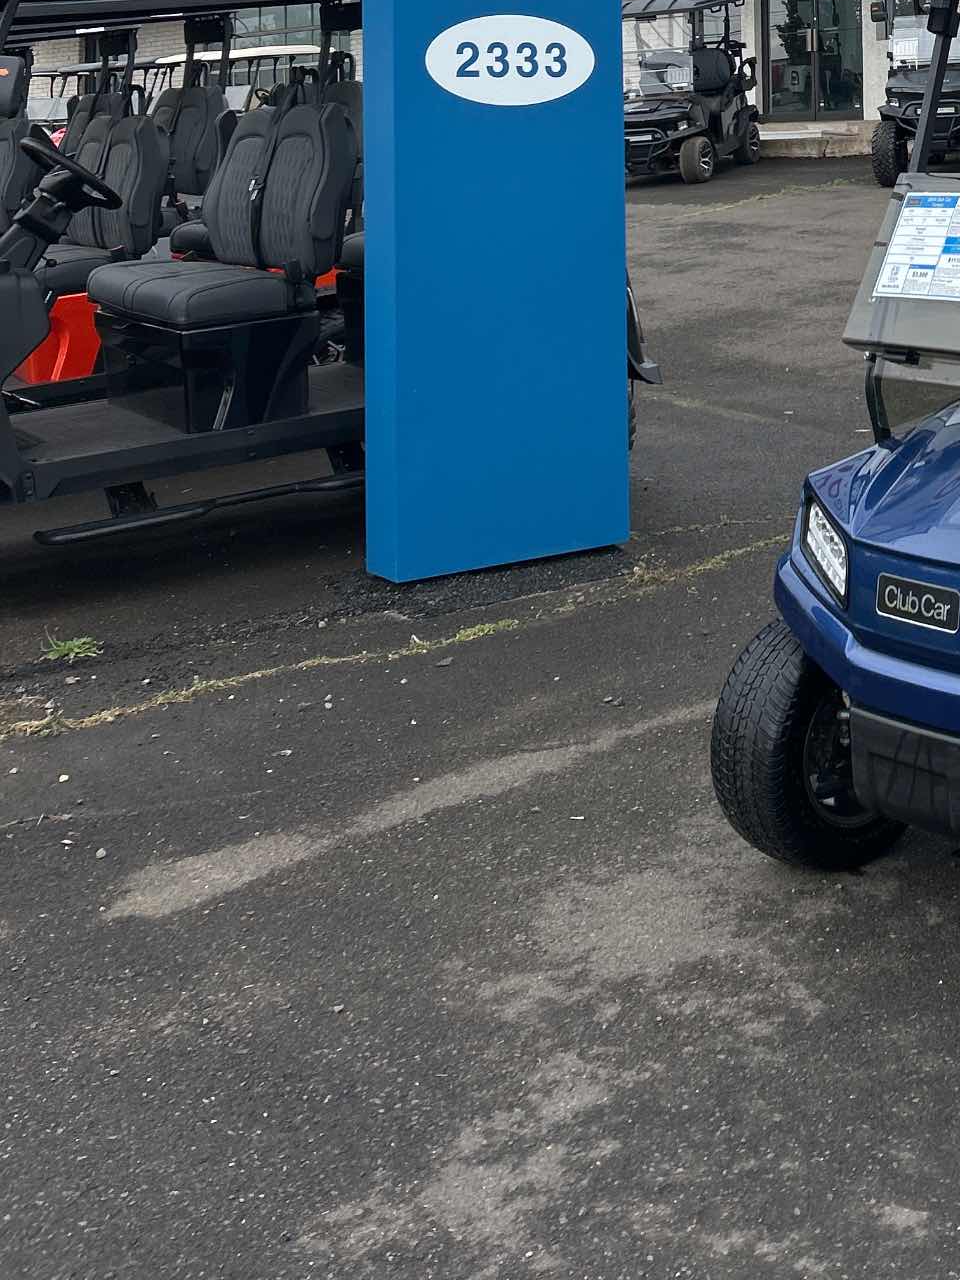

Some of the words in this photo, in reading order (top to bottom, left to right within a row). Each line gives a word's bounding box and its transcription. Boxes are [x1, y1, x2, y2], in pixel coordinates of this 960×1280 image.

[456, 41, 568, 78] 2333
[884, 585, 919, 614] Club
[921, 594, 951, 622] Car
